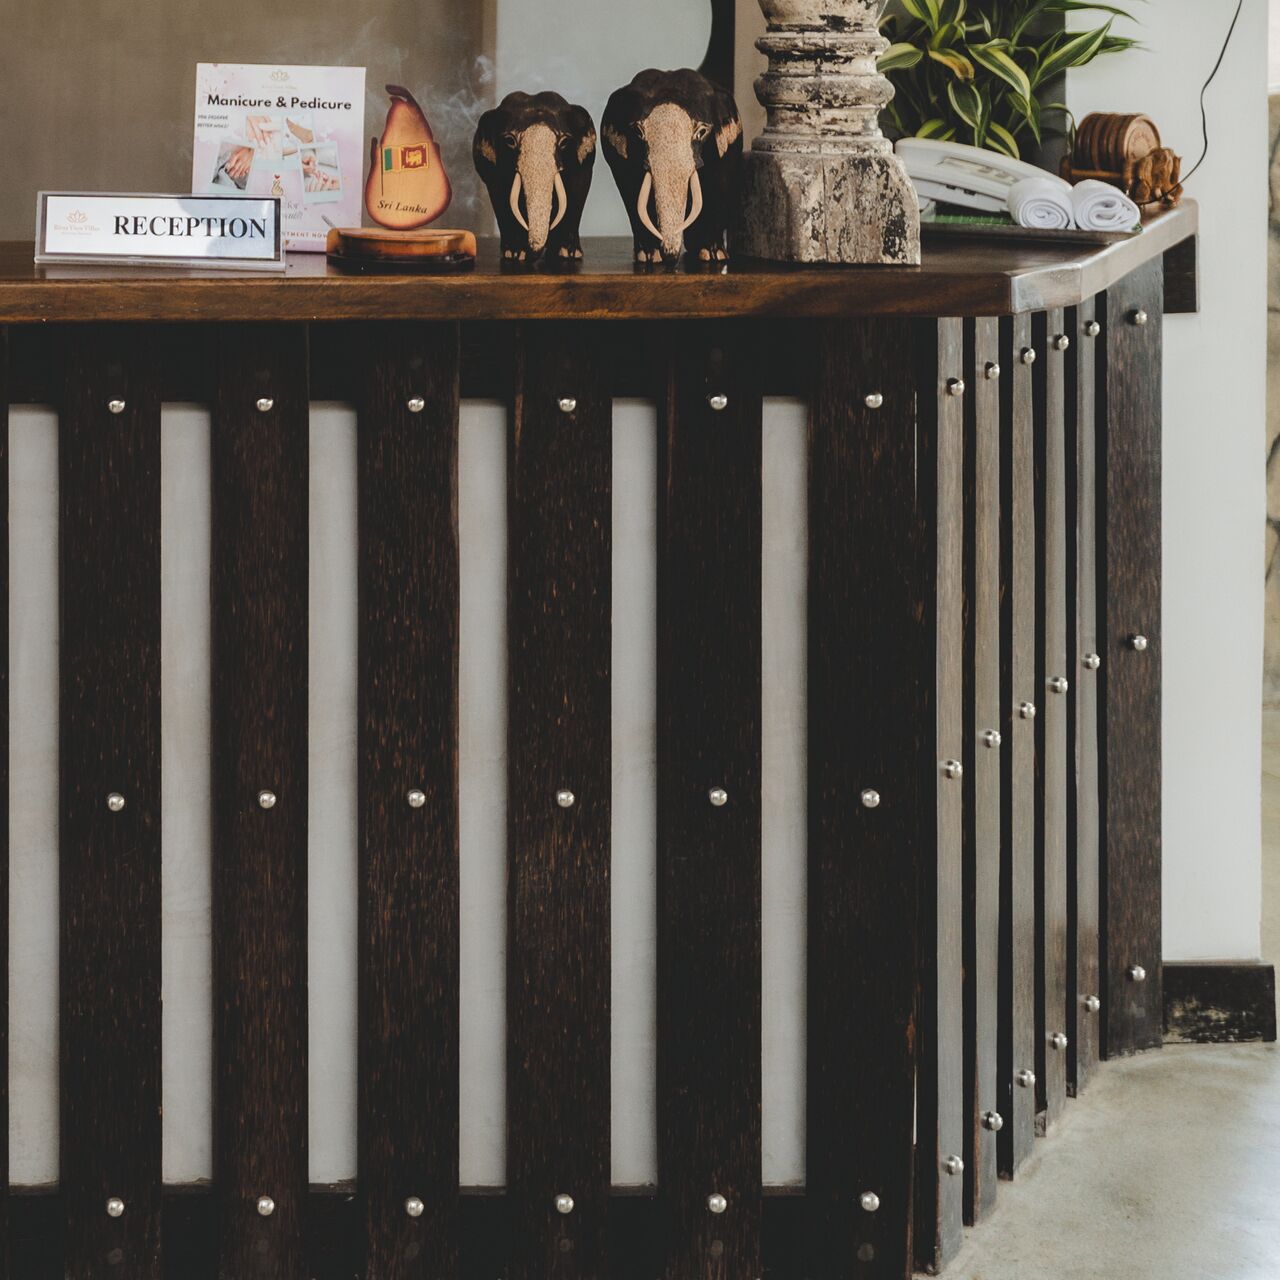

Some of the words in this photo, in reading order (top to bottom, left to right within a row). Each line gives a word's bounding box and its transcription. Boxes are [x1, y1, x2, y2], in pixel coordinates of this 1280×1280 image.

[207, 94, 271, 108] Manicure
[276, 96, 287, 108] &
[291, 97, 352, 110] Pedicure
[377, 200, 393, 210] Sri
[395, 202, 428, 214] Lanka
[113, 214, 268, 239] RECEPTION
